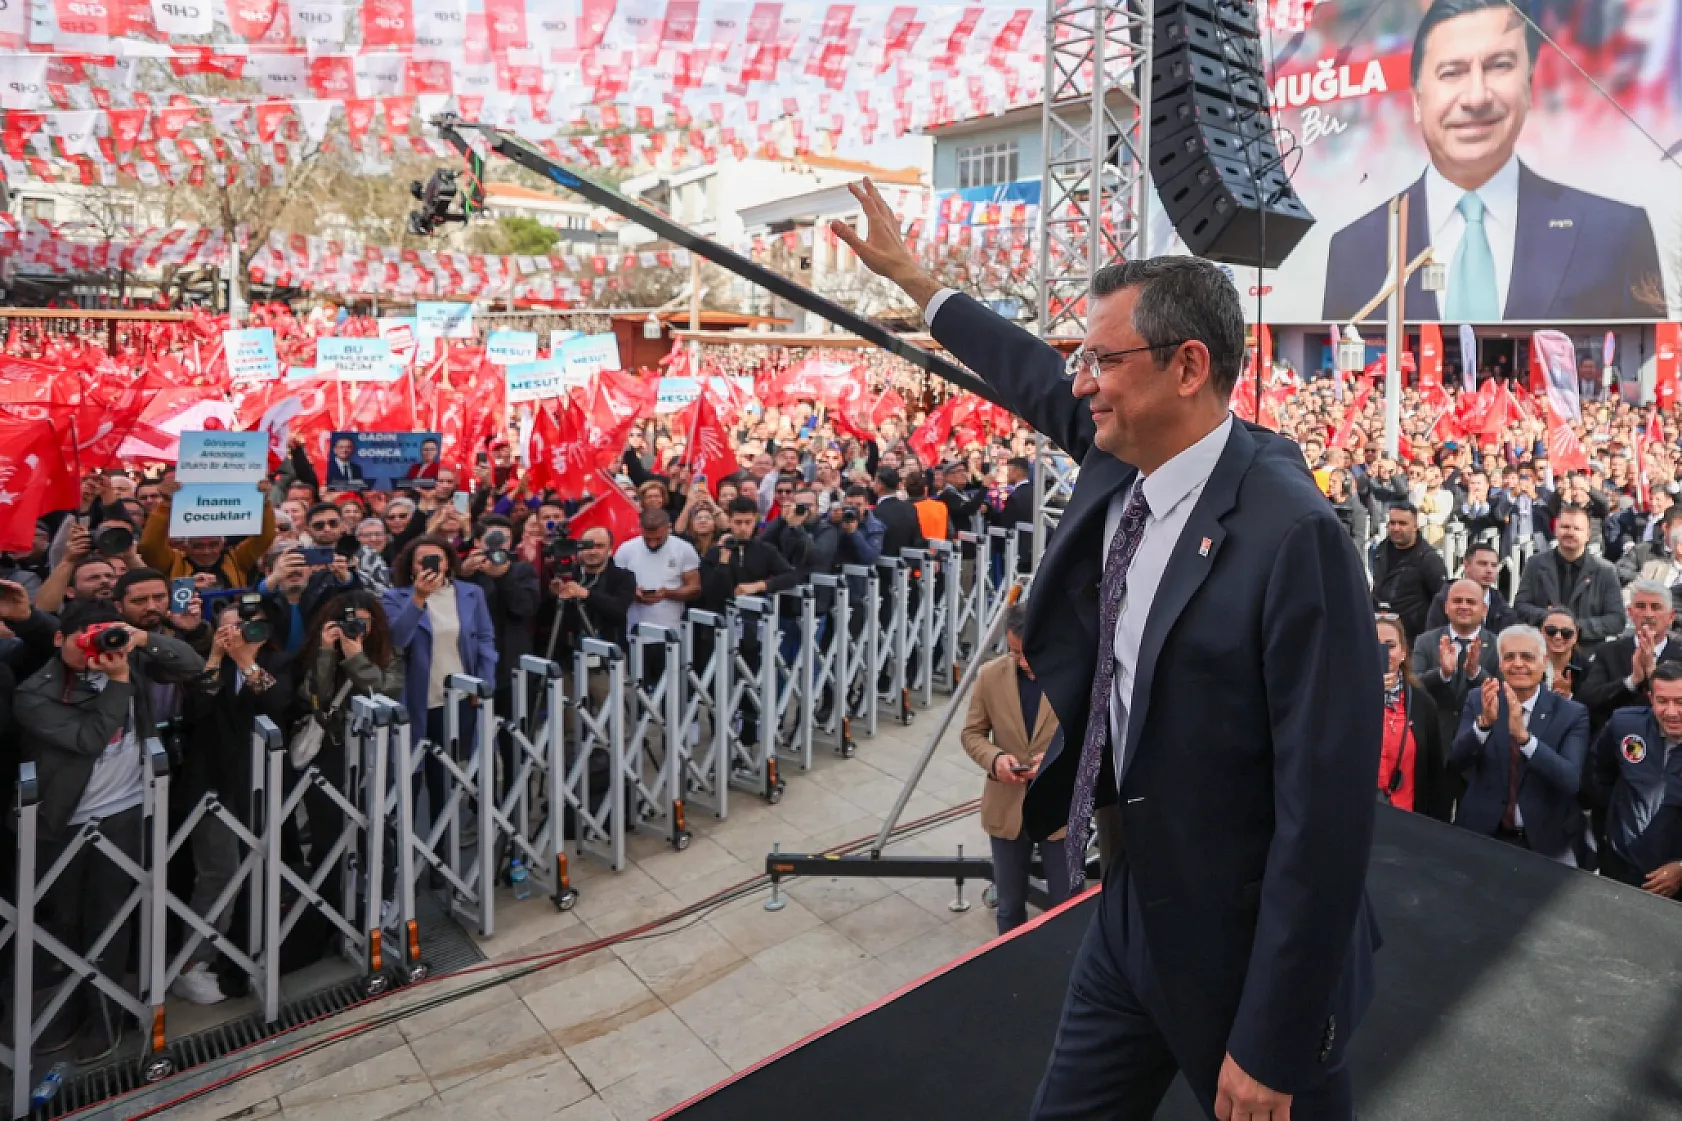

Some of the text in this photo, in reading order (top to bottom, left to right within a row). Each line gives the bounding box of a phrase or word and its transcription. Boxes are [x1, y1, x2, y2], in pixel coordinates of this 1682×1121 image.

[1268, 59, 1388, 109] MUĞLA
[1301, 106, 1348, 146] Bir
[511, 378, 560, 389] MESUT
[658, 394, 695, 402] MESU
